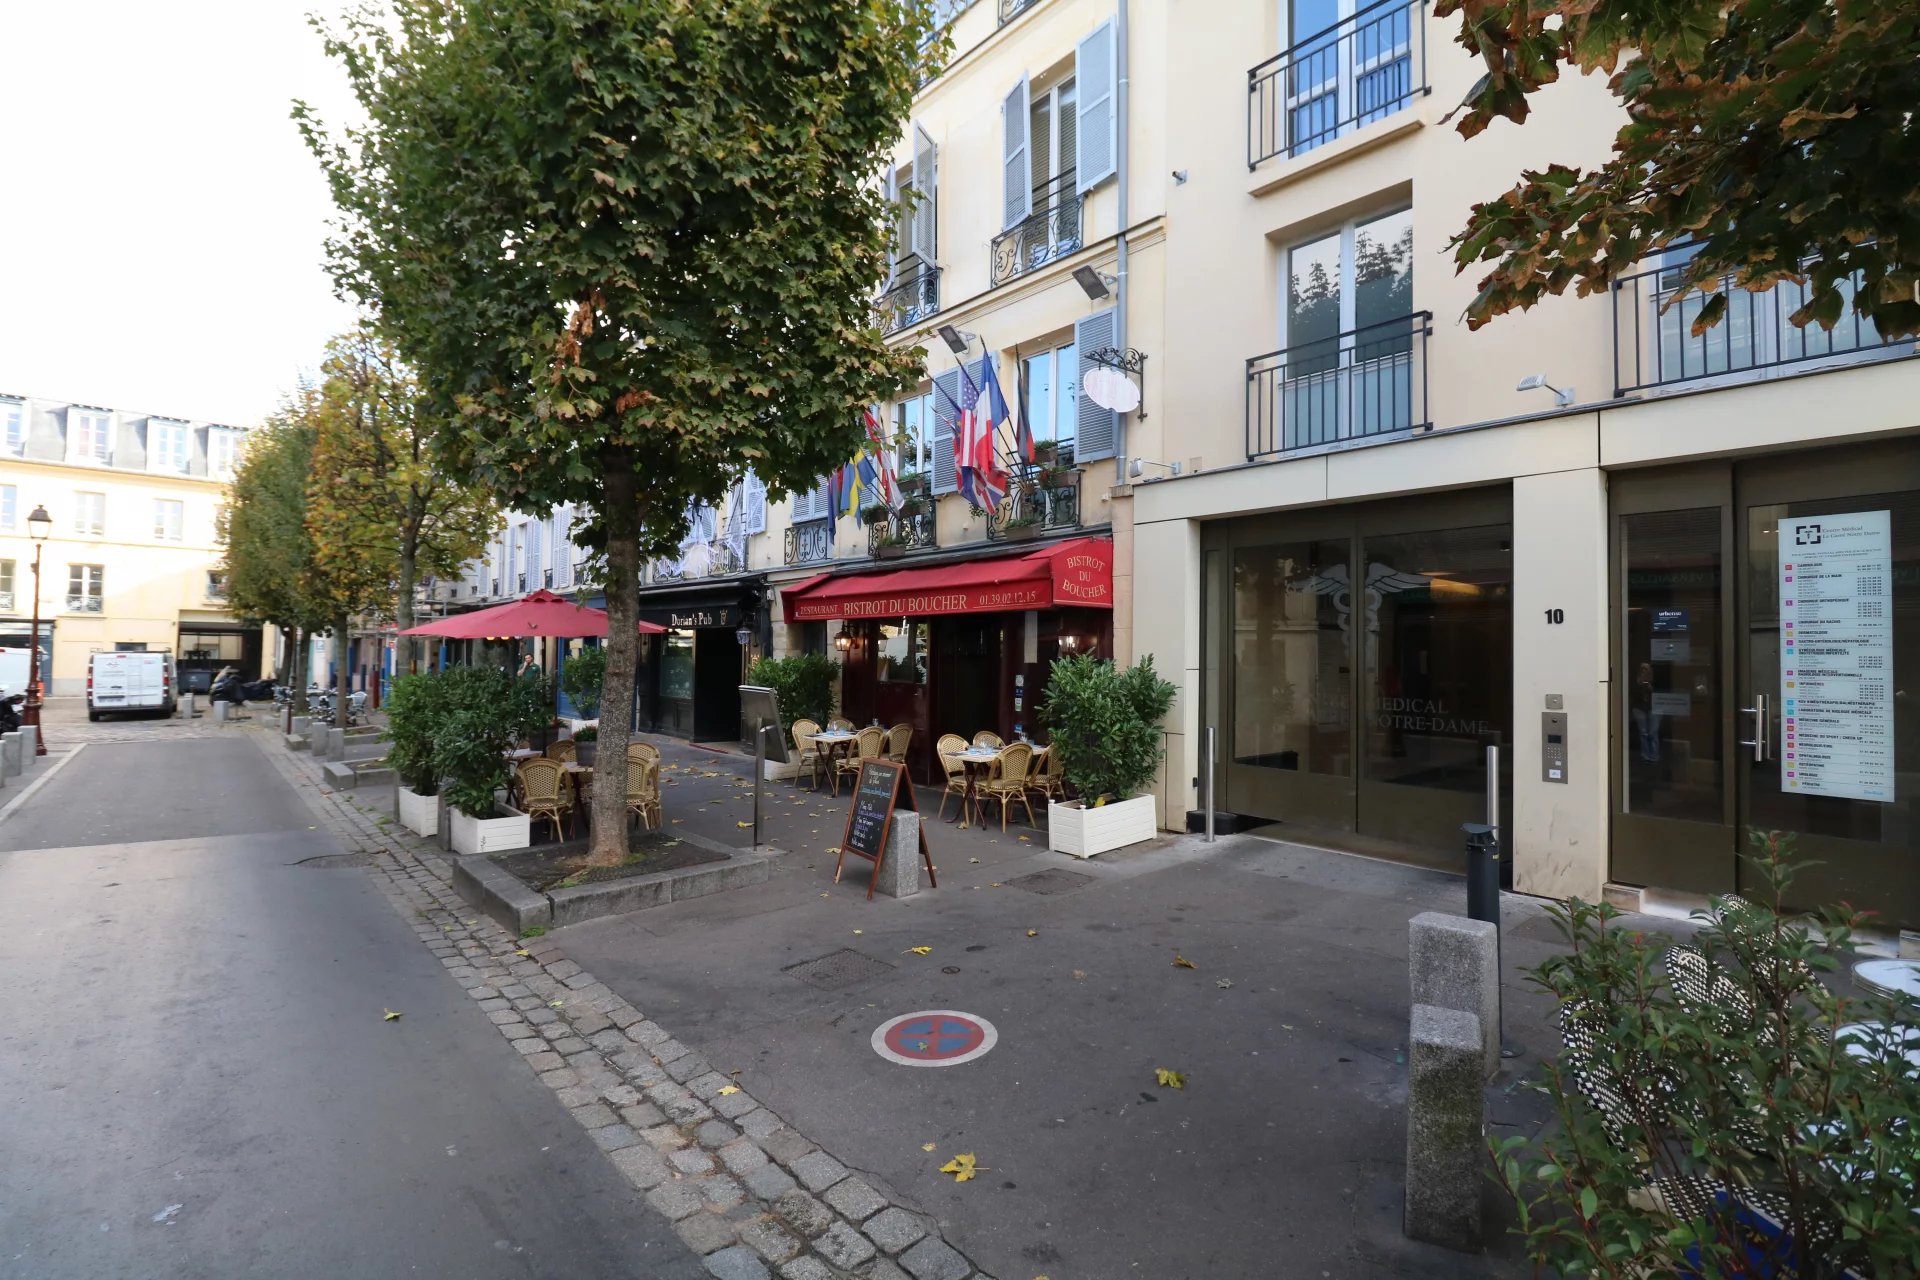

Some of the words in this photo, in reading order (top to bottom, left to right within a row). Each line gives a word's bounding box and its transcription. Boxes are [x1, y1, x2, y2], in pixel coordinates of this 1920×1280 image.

[1066, 556, 1105, 571] BISTROT
[1079, 571, 1091, 582] DU
[1062, 578, 1107, 598] BOUCHER
[844, 600, 887, 616] BISTROT
[890, 599, 907, 613] DU
[908, 595, 967, 612] BOUCHER
[979, 591, 1037, 605] 01.39.02.12.15
[671, 613, 697, 626] Dorian's
[698, 612, 712, 625] Pub
[1544, 608, 1564, 624] 10
[1377, 713, 1489, 735] OTRE-DAME
